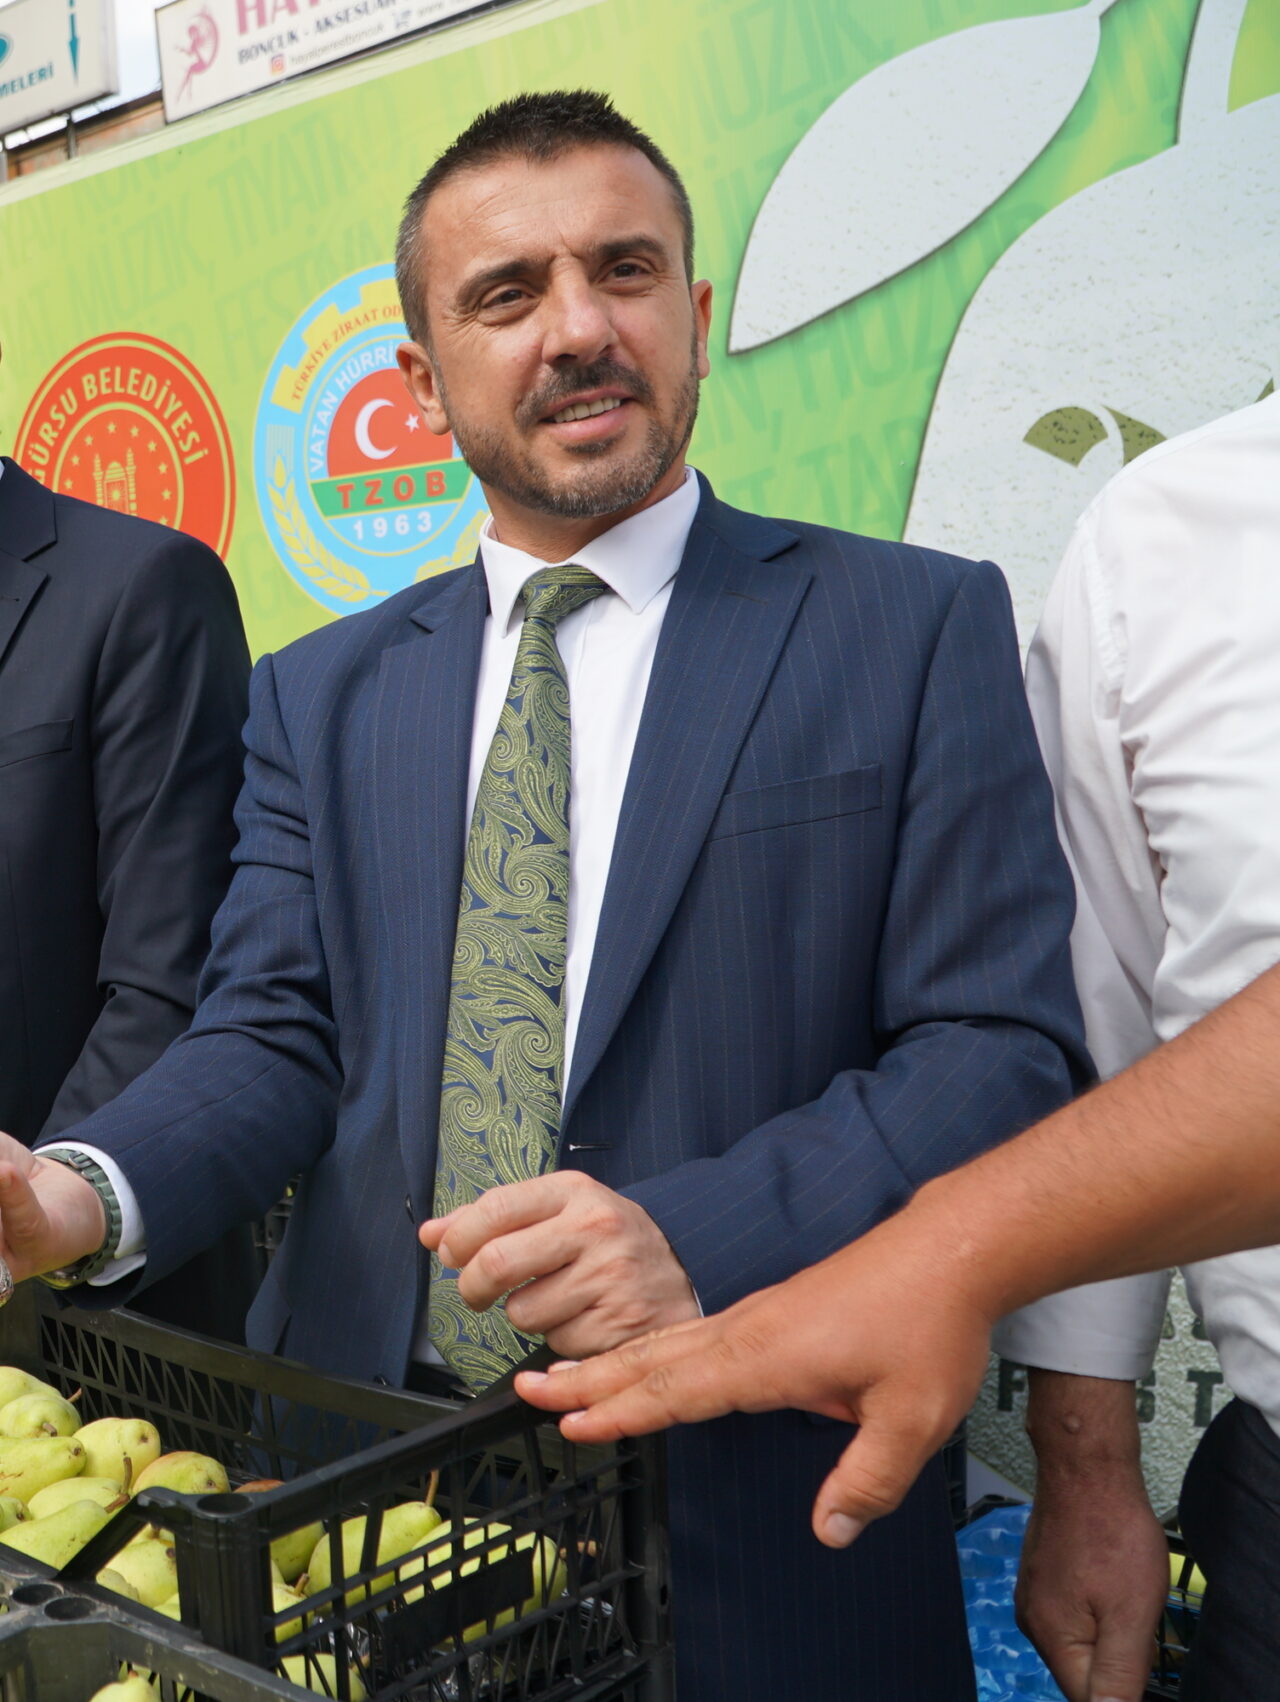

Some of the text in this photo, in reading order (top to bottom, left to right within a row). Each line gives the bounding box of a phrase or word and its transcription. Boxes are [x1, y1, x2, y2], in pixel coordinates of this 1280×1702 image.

[237, 29, 299, 65] BONCUK
[291, 303, 403, 402] TÜRKİYE ZİRAAT OD
[81, 365, 209, 466] BELEDİYESİ
[310, 339, 400, 474] VATAN HÜRRİ
[335, 470, 448, 510] TZOB
[353, 510, 433, 541] 1963
